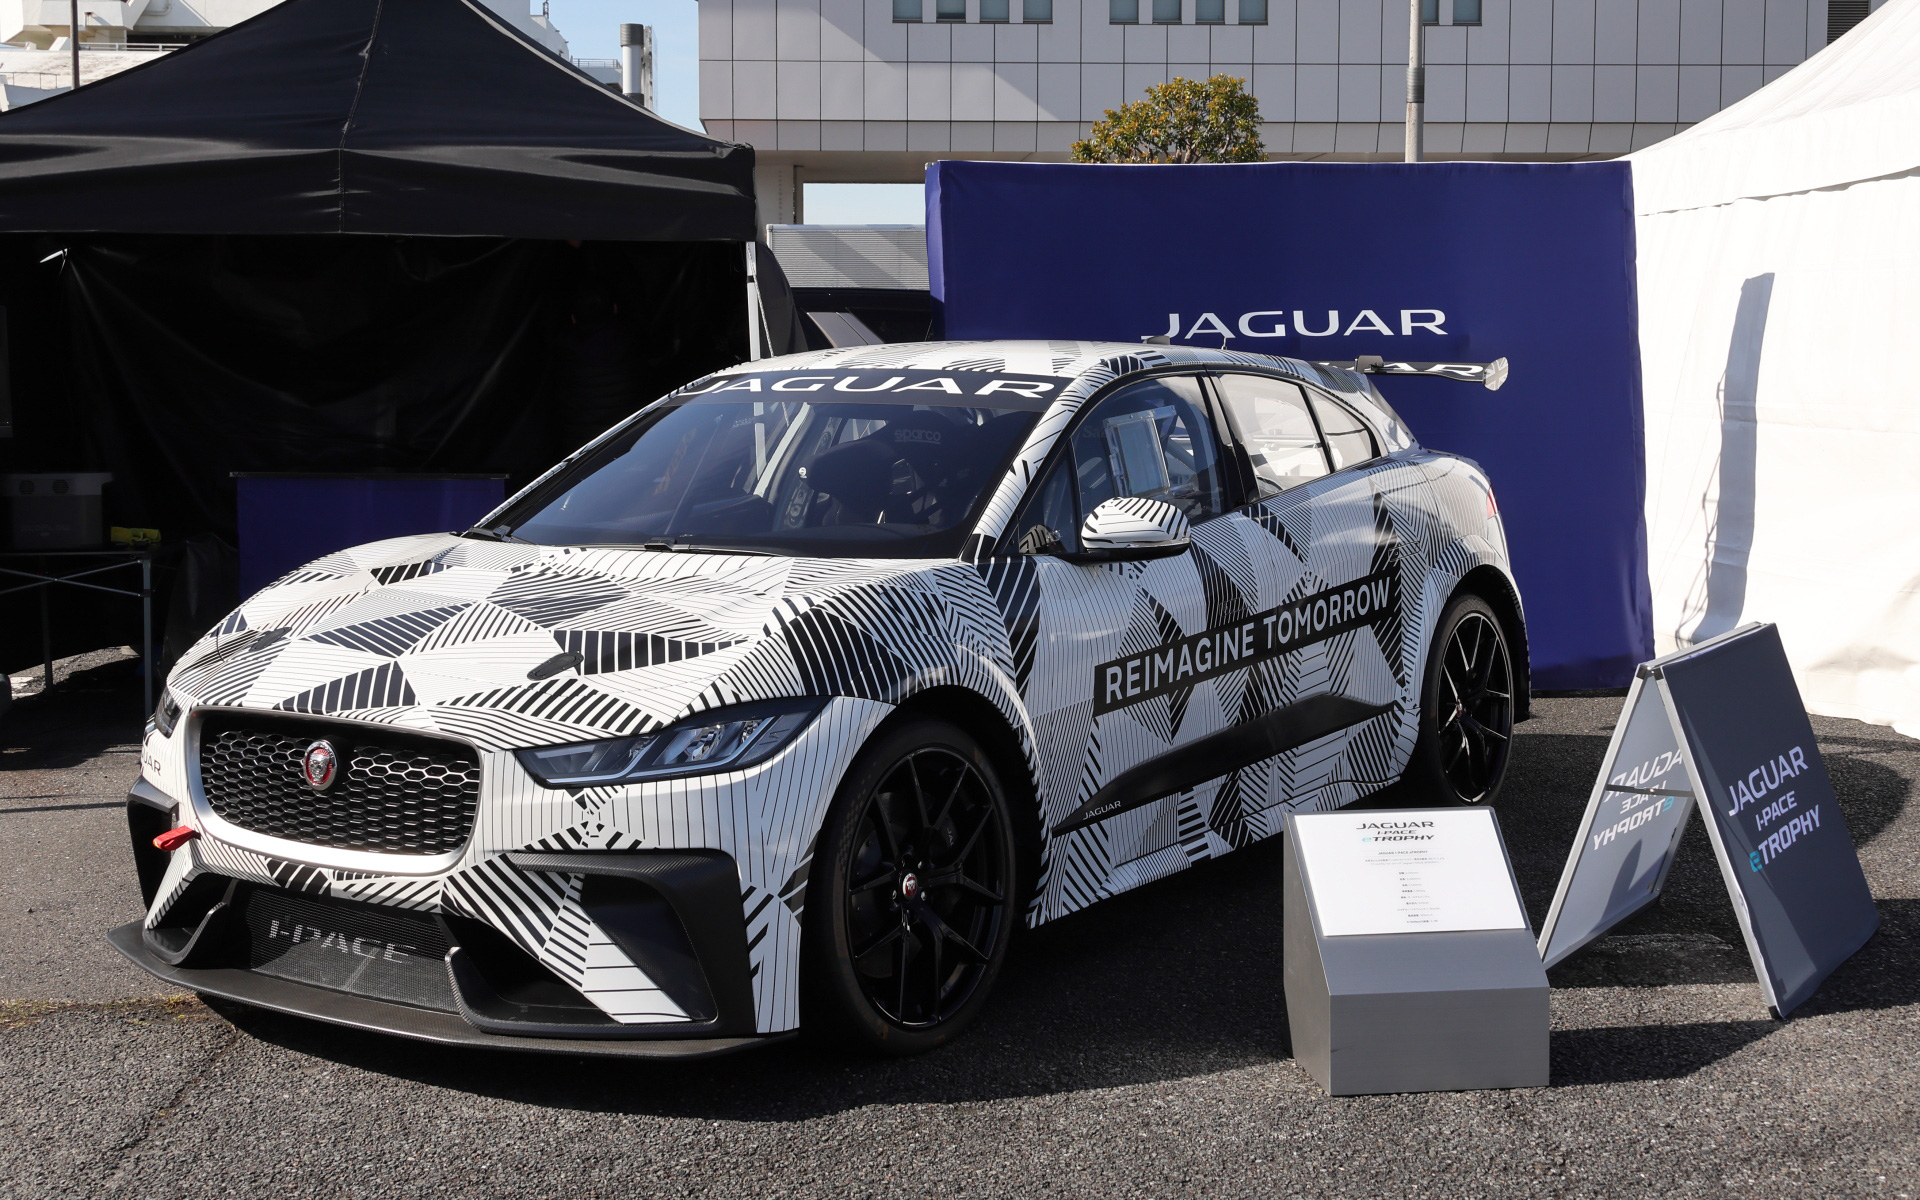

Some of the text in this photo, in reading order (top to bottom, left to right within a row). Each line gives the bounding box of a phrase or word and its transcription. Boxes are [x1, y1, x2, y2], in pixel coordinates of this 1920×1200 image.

[1141, 309, 1449, 340] JAGUAR
[677, 376, 1055, 399] JAGUAR
[894, 429, 941, 443] sparco
[1105, 576, 1391, 704] REIMAGINE TOMORROW
[142, 750, 161, 776] UAR
[1728, 746, 1809, 817] JAGUAR
[1082, 800, 1122, 821] JAGUAR
[1356, 821, 1434, 829] JAGUAR
[1755, 790, 1798, 831] I-PACE
[1749, 805, 1820, 872] eTROPHY
[268, 919, 417, 965] I-PACE
